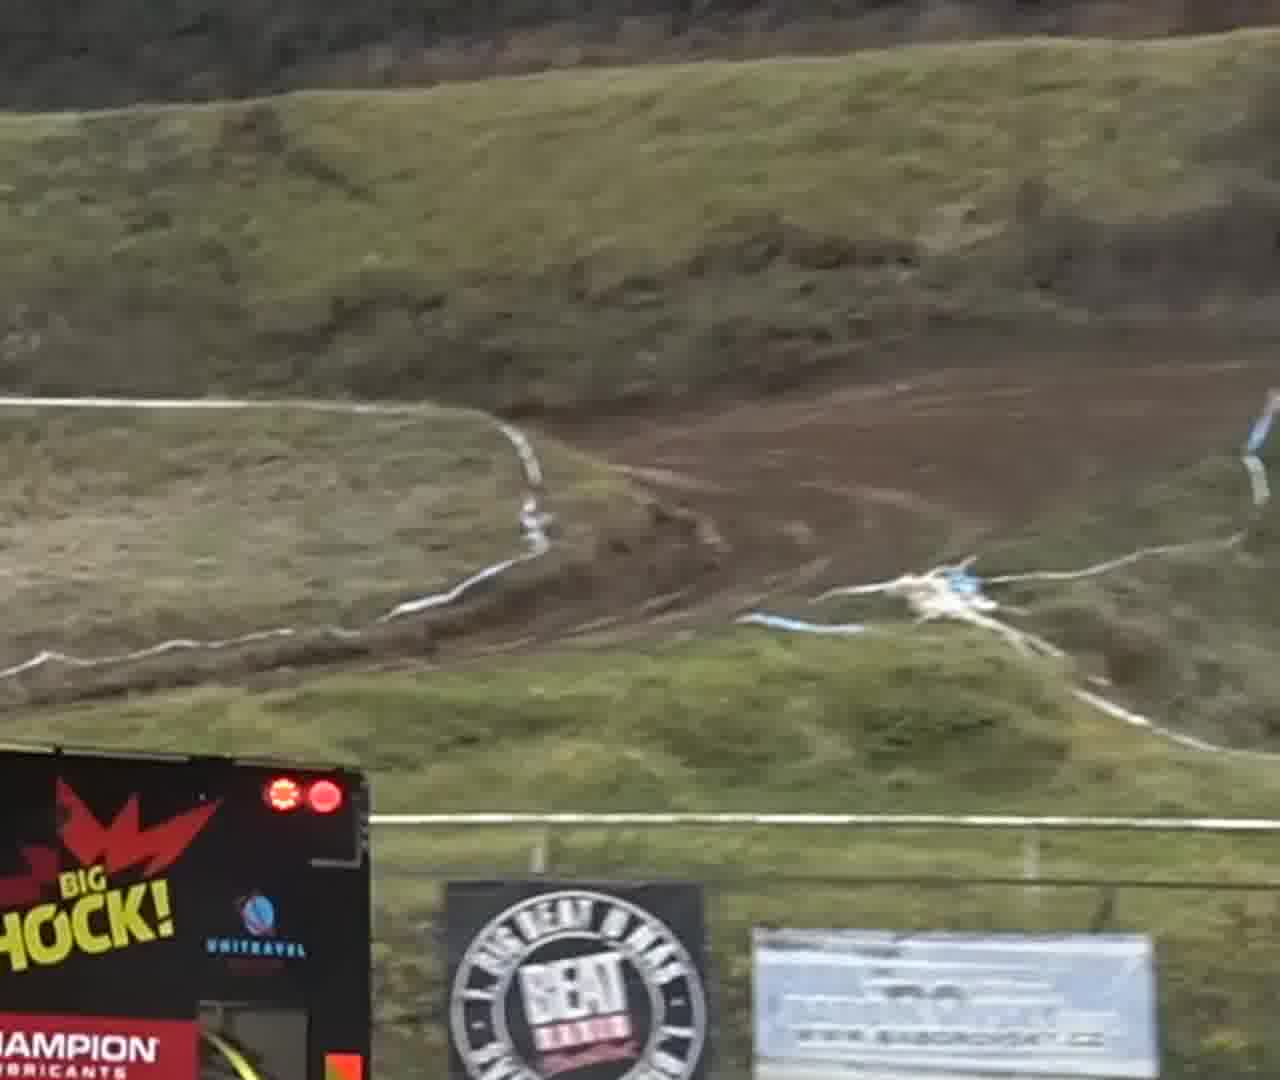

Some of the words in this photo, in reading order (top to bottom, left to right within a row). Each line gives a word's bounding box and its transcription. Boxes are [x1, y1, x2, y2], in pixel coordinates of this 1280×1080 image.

[58, 865, 107, 899] BIG
[205, 937, 307, 959] UNITRAVEL
[520, 952, 628, 1026] BEAT
